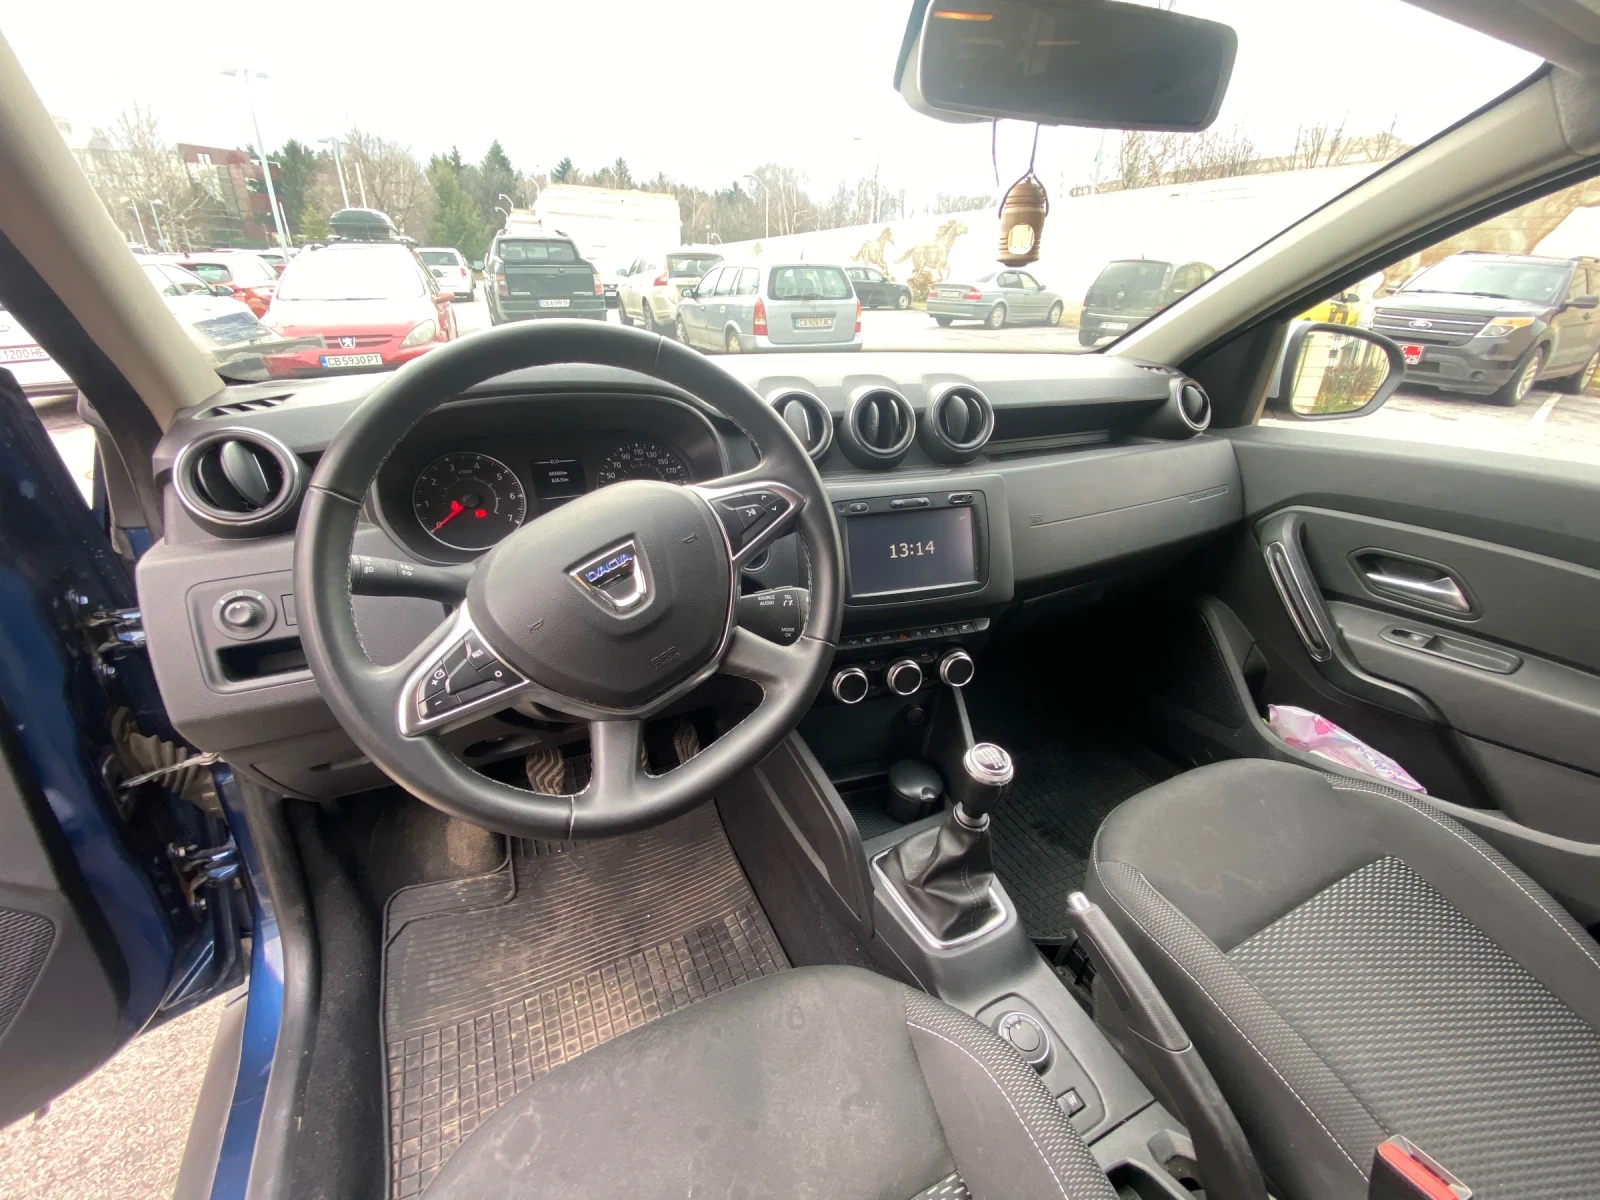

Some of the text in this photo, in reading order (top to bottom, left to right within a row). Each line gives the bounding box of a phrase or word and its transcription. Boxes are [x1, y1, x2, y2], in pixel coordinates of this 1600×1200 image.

[449, 464, 455, 472] 3
[612, 461, 621, 469] 70
[496, 472, 503, 481] 5
[431, 478, 437, 486] 2
[509, 492, 516, 500] 6
[425, 500, 429, 508] 1
[507, 514, 513, 522] 7
[436, 521, 442, 529] 0
[889, 540, 935, 559] 13:14
[585, 553, 633, 583] DACIA
